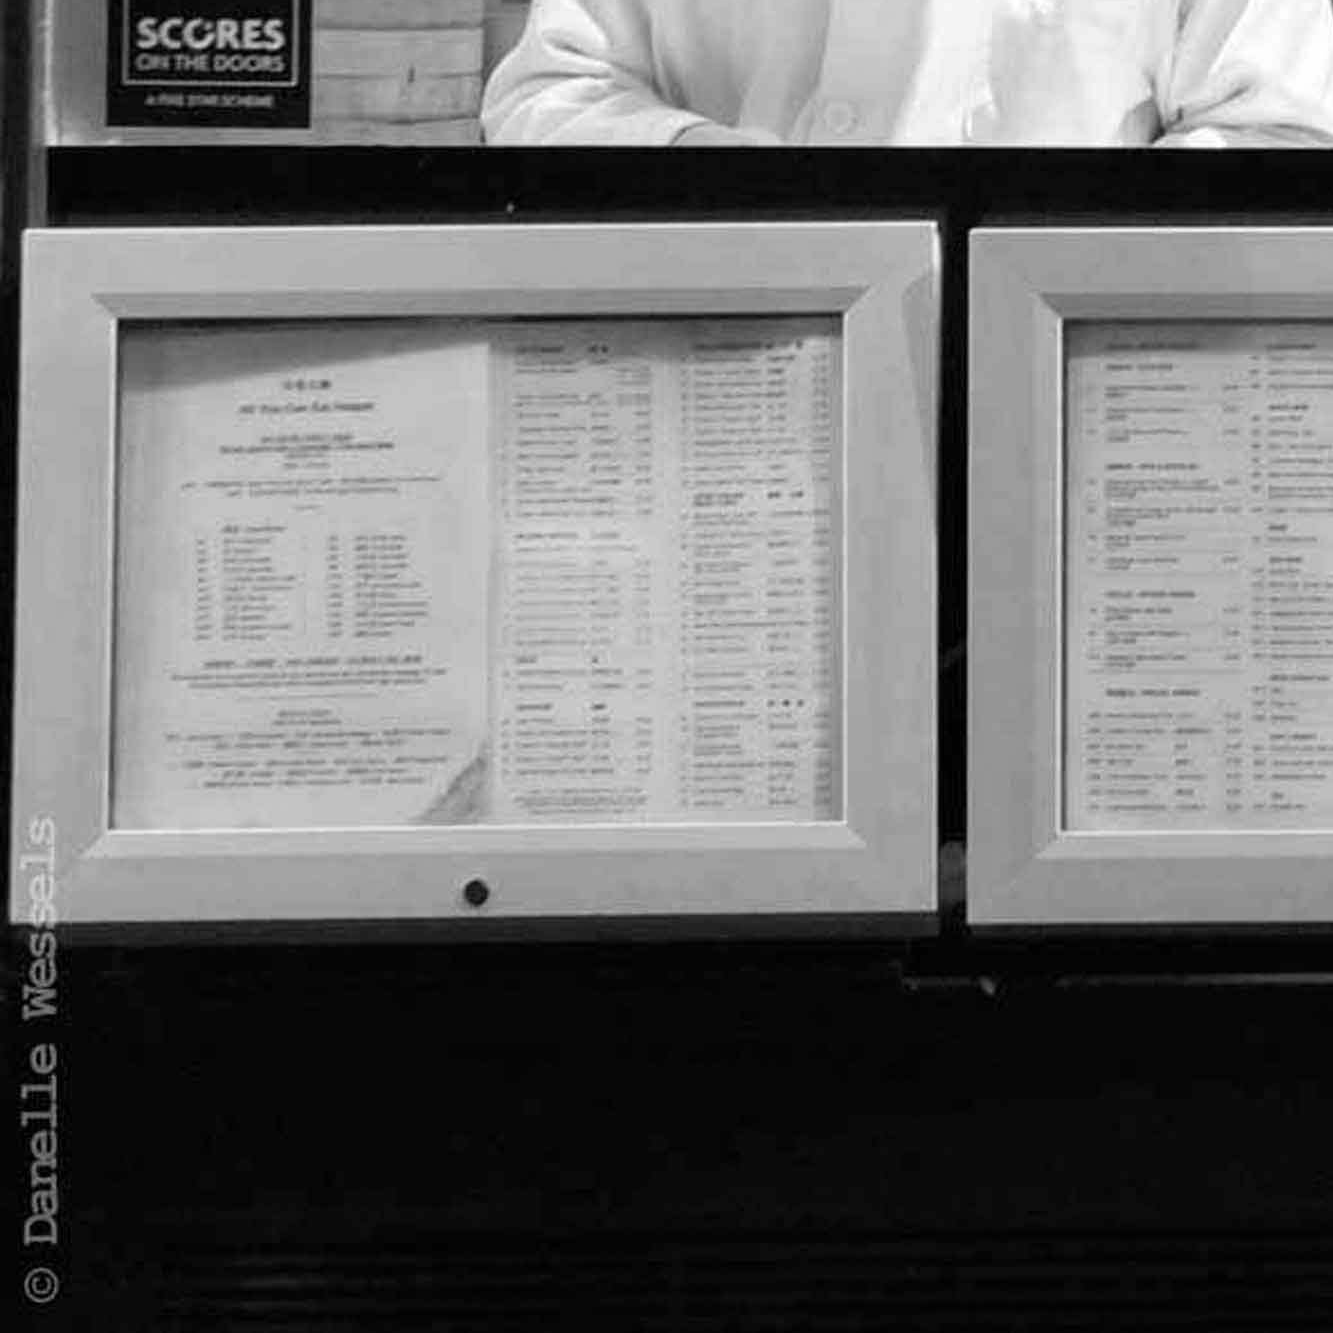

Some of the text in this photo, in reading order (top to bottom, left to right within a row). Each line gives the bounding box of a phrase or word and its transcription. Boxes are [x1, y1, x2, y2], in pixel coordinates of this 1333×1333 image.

[136, 18, 286, 51] SCORES
[135, 53, 286, 72] ON THE DOORS
